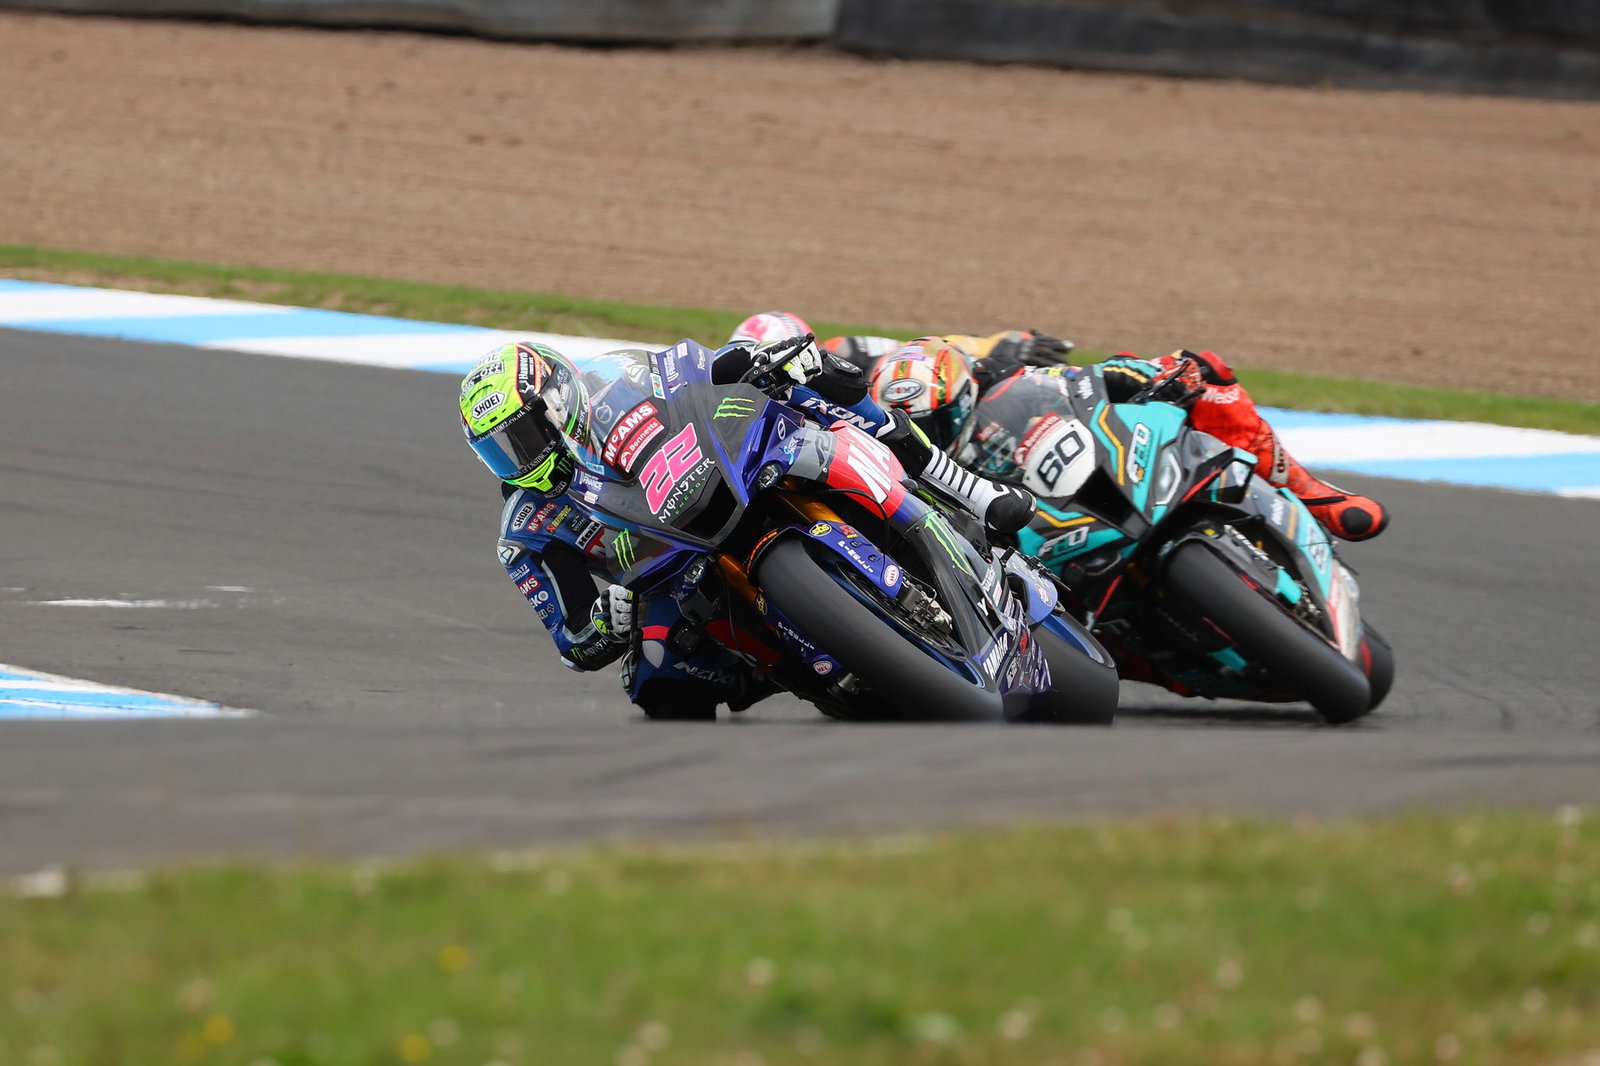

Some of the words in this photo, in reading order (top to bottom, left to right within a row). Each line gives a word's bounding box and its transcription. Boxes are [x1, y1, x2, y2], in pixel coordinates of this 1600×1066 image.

[474, 394, 501, 417] SHOEI
[800, 397, 876, 430] IXON
[629, 421, 659, 452] Bennetts
[639, 422, 704, 515] 22
[1036, 430, 1086, 493] 60
[658, 457, 716, 523] MONSTER
[675, 476, 706, 515] ENERGY
[517, 504, 533, 528] SHOEI
[837, 540, 874, 574] PIRELLI
[777, 621, 815, 650] PIRELLI
